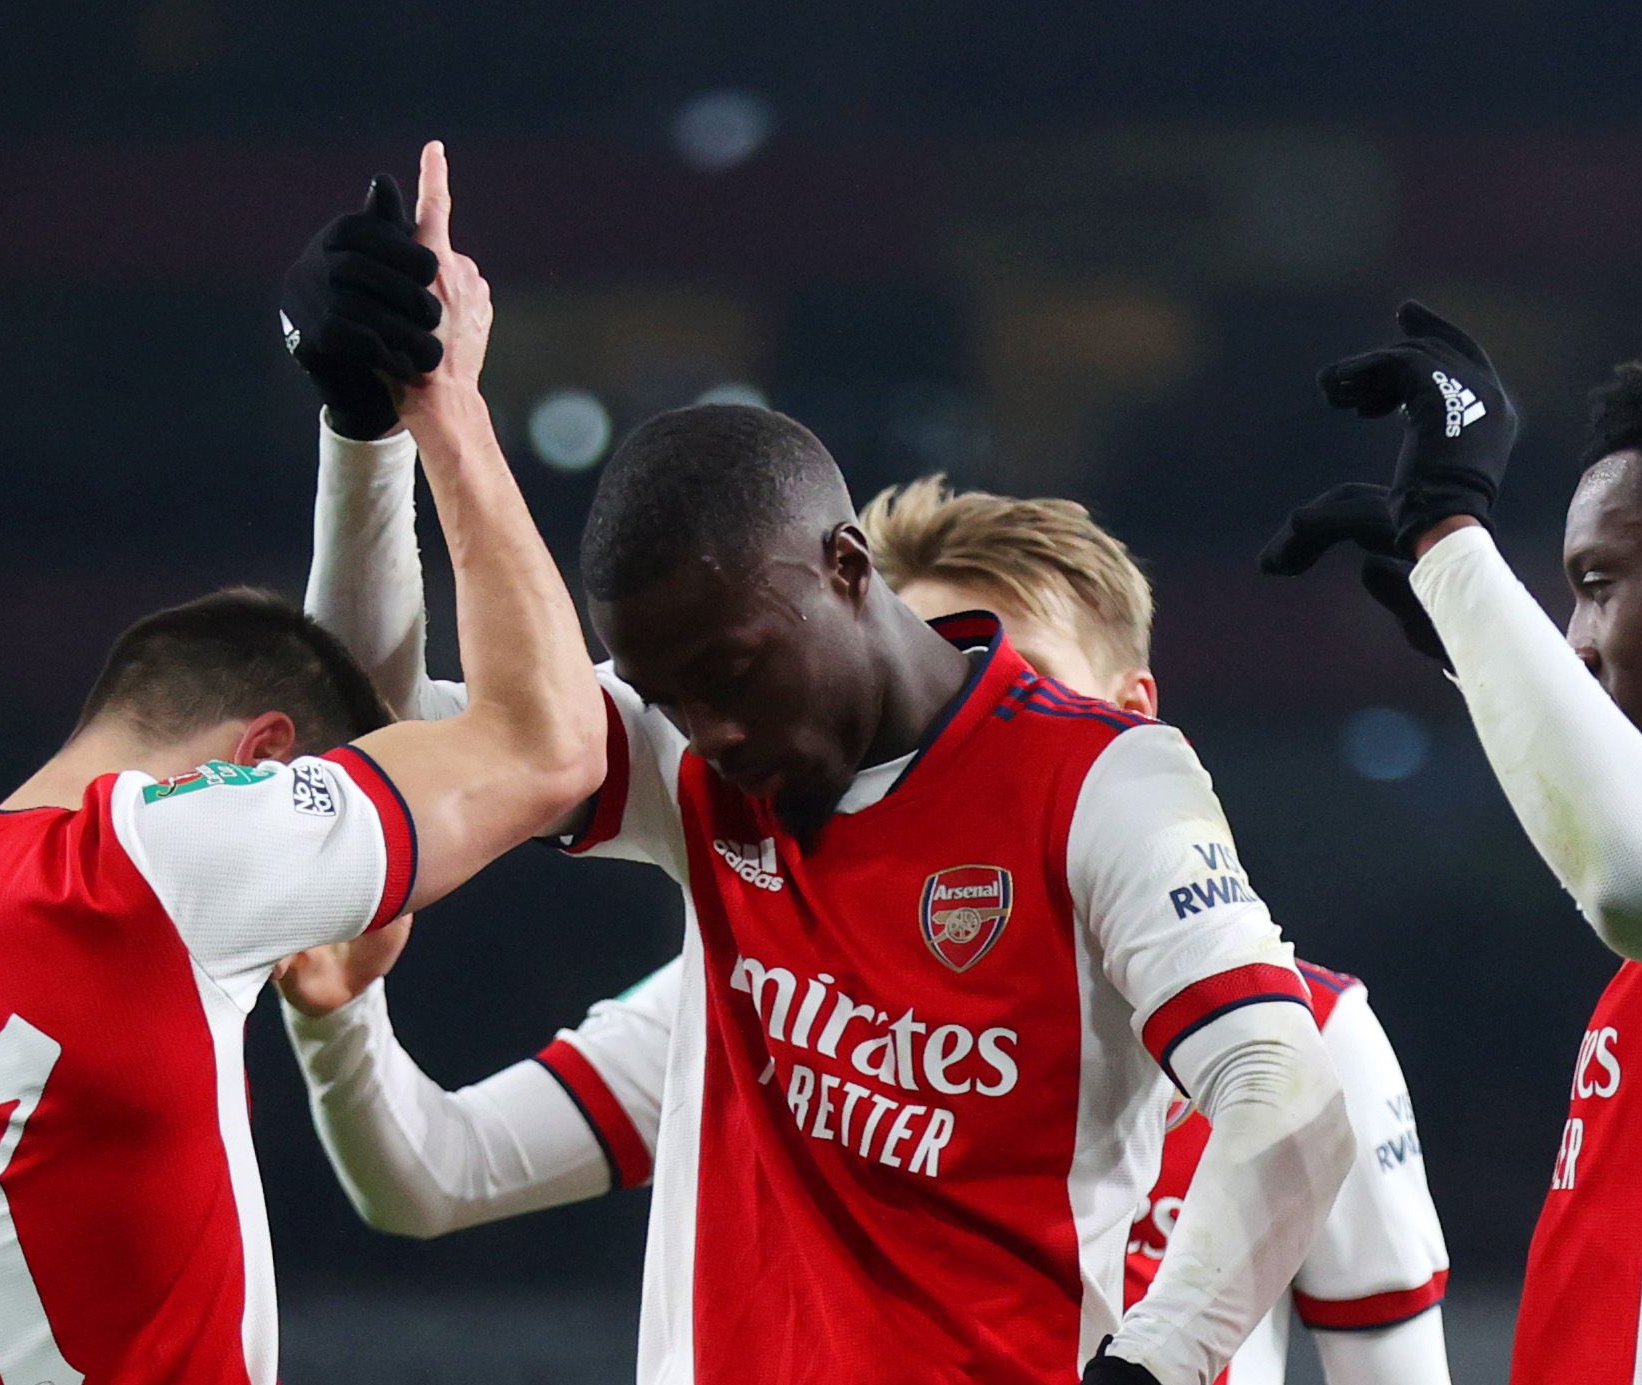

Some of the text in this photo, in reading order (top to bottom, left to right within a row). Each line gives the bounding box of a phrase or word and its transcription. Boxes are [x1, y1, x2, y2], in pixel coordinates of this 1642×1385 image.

[1431, 370, 1465, 438] adidas
[713, 838, 785, 893] adidas
[933, 880, 1000, 902] Arsenal
[730, 953, 1019, 1098] mirates
